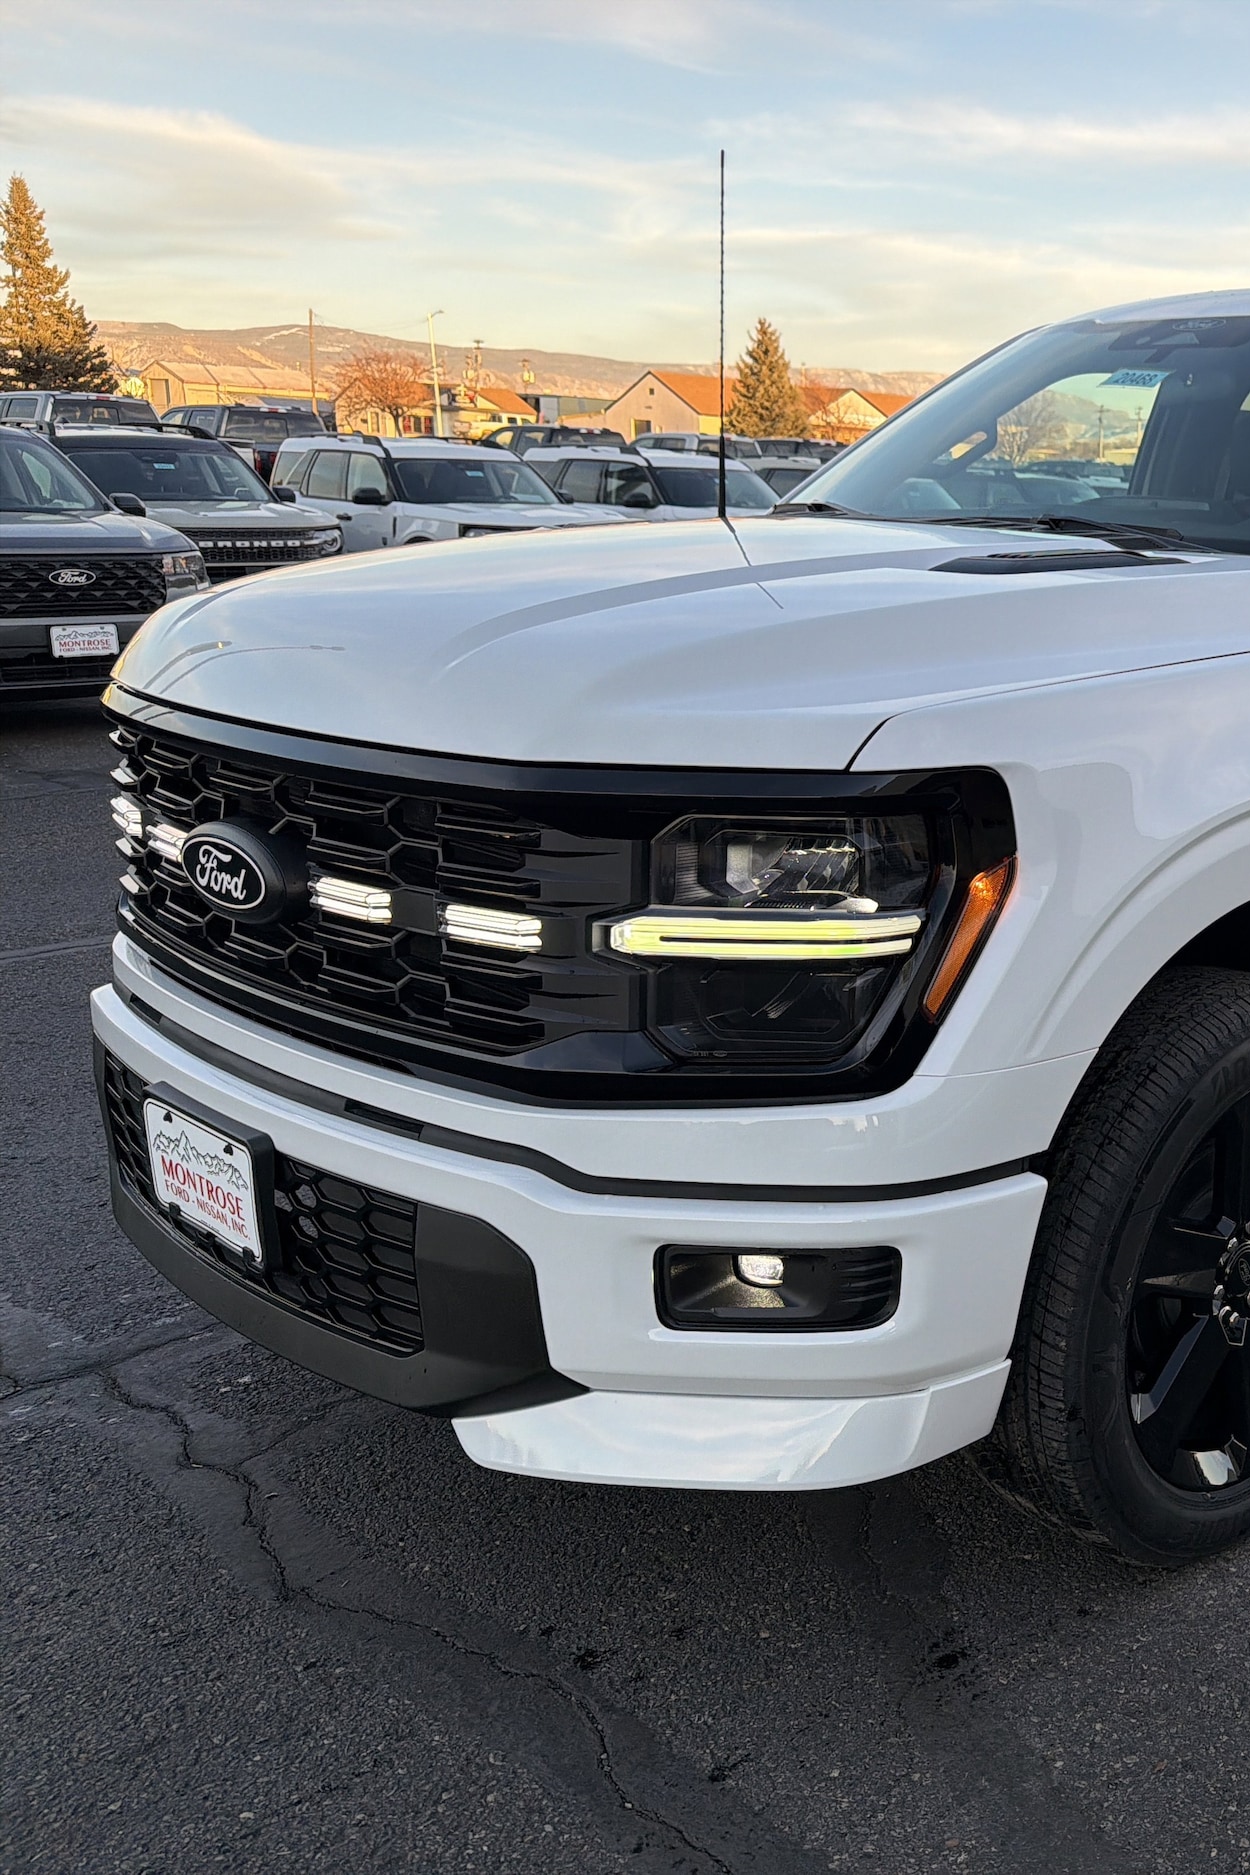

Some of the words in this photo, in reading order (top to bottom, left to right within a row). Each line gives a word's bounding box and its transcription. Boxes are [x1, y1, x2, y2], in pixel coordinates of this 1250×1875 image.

[198, 540, 301, 548] BRONCO
[58, 571, 88, 583] Ford
[58, 639, 111, 649] MONTROSE
[195, 844, 247, 901] Ford
[161, 1154, 246, 1222] MONTROSE
[165, 1178, 190, 1203] FORD
[196, 1196, 232, 1231] NISSAN,
[231, 1217, 251, 1241] INC.
